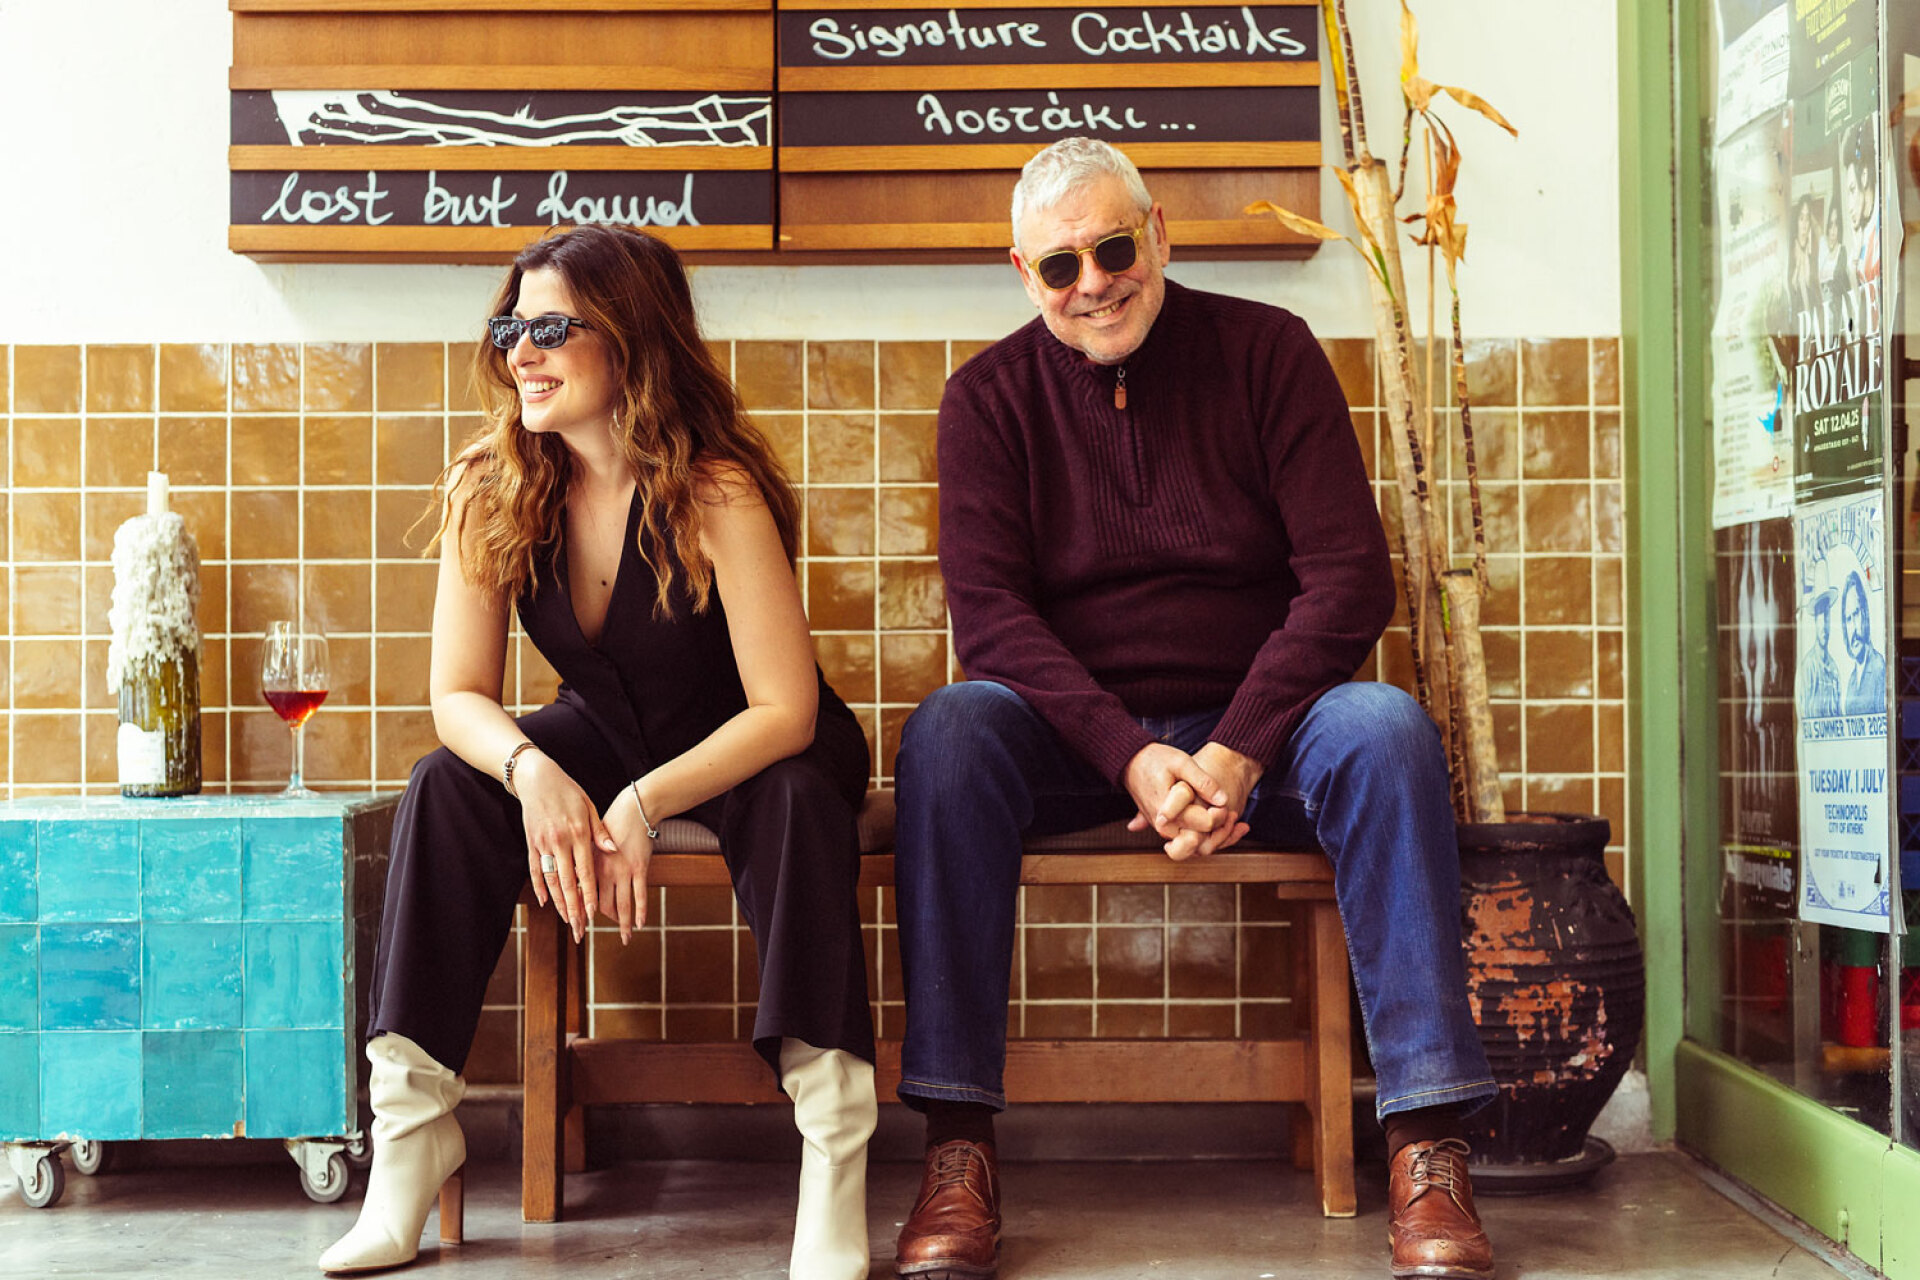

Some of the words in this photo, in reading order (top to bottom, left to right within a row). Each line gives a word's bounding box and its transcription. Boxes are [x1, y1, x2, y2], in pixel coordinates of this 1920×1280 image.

[808, 10, 1047, 60] Signature
[1070, 5, 1307, 57] Cocktails
[261, 171, 395, 225] lost
[422, 170, 518, 227] but
[536, 170, 701, 227] found
[1797, 280, 1881, 364] PALAYE
[1794, 337, 1882, 416] ROYALE
[1813, 415, 1830, 437] SAT
[1831, 407, 1860, 432] 12.04.25
[1813, 719, 1845, 738] SUMMER
[1845, 717, 1866, 736] TOUR
[1867, 715, 1888, 735] 2025
[1861, 768, 1885, 793] JULY
[1824, 804, 1867, 821] TECHNOPOLIS
